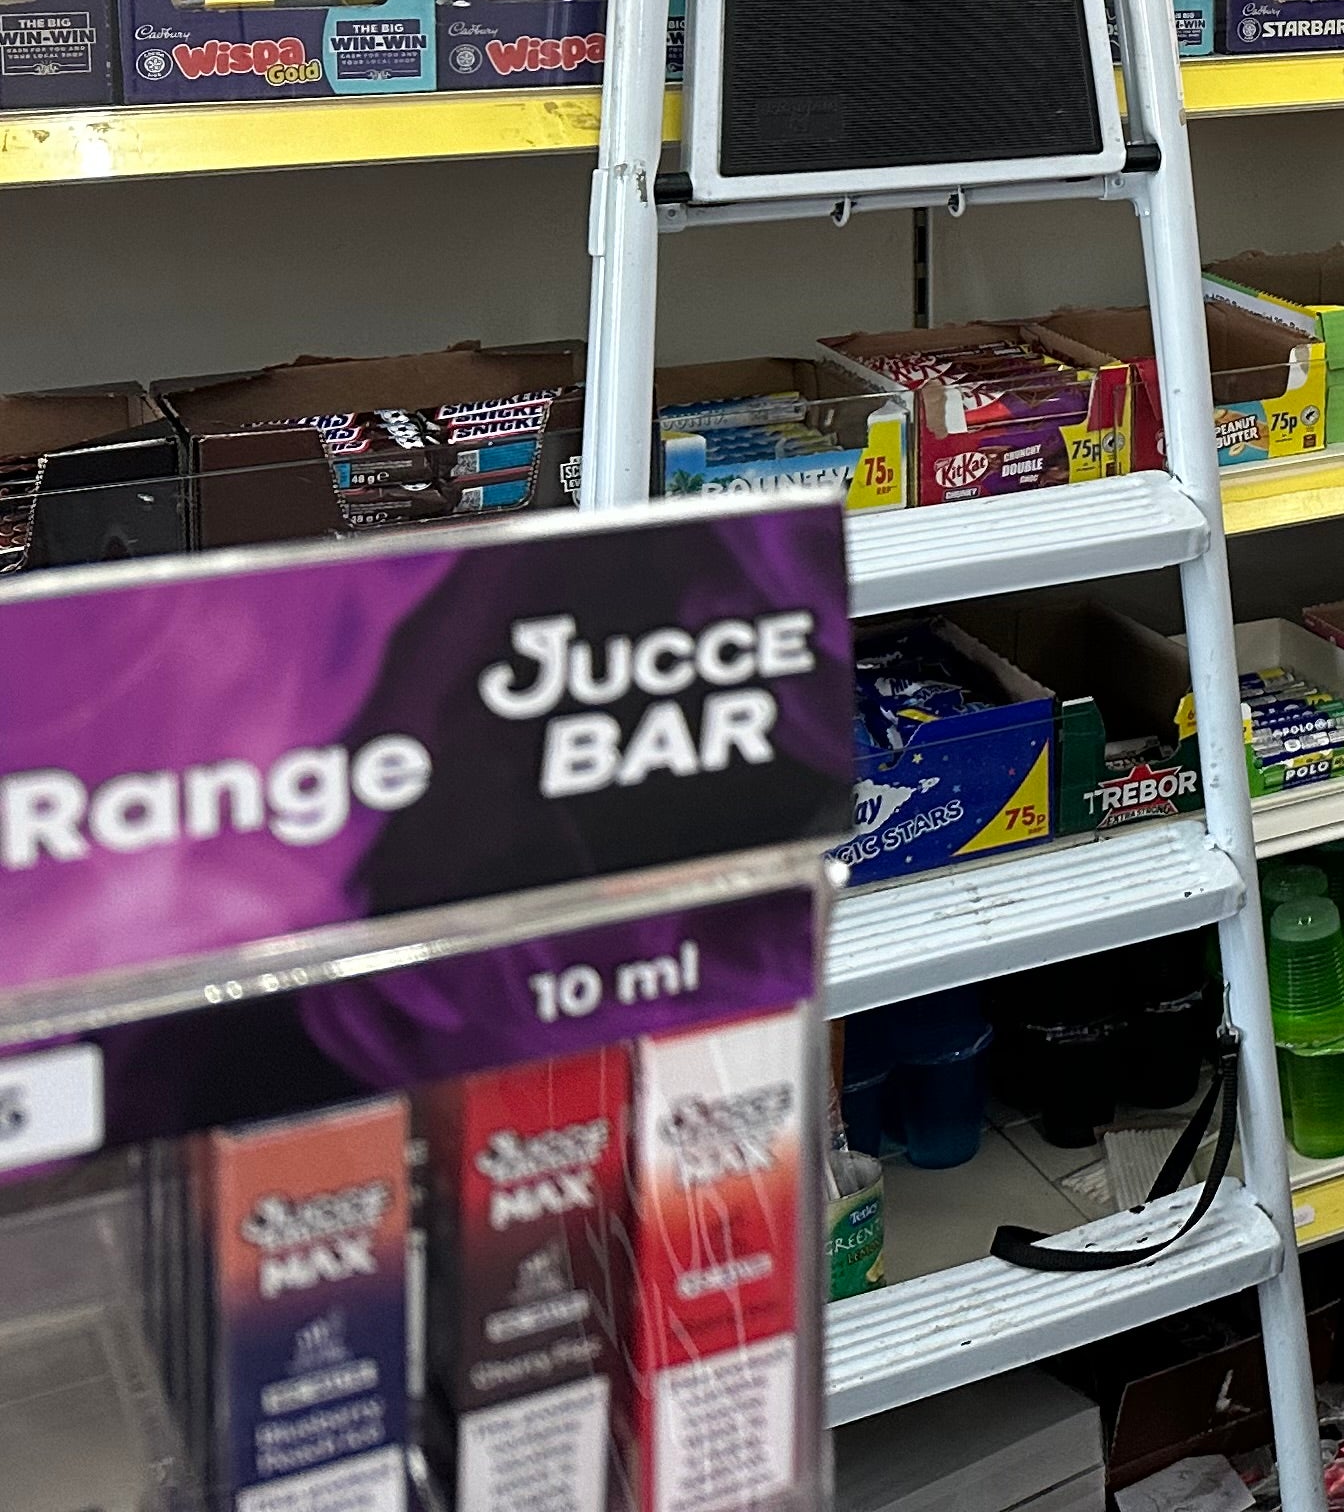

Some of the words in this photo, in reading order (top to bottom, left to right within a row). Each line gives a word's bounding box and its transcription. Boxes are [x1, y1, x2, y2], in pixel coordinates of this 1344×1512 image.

[1242, 2, 1281, 17] Cadbury
[18, 18, 42, 28] THE
[45, 17, 71, 28] BIG
[135, 24, 190, 41] Cadbury
[353, 24, 377, 34] THE
[380, 24, 404, 33] BIG
[448, 22, 499, 37] Cadbury
[1, 29, 96, 44] WIN-WIN
[330, 34, 427, 52] WIN-WIN
[172, 37, 306, 80] Wispa
[485, 33, 606, 76] Wispa
[265, 61, 321, 86] Gold
[1271, 412, 1297, 433] 75p
[1004, 444, 1042, 461] CRUNCHY
[1072, 440, 1101, 463] 75p
[352, 474, 365, 484] 48
[864, 456, 894, 486] 75p
[940, 452, 986, 486] KitKat
[1002, 459, 1043, 477] DOUBLE
[945, 489, 978, 499] CHUNKY
[478, 611, 817, 721] JUCCE
[1283, 721, 1314, 736] POLO
[538, 687, 779, 799] BAR
[1285, 761, 1330, 780] POLO
[0, 733, 432, 873] Range
[1084, 770, 1197, 816] TREBOR
[1005, 805, 1047, 833] 75p
[1105, 810, 1135, 827] EXTRA
[1136, 801, 1173, 818] STRONG
[883, 800, 963, 852] STARS
[528, 962, 604, 1025] 10
[615, 939, 700, 1004] ml
